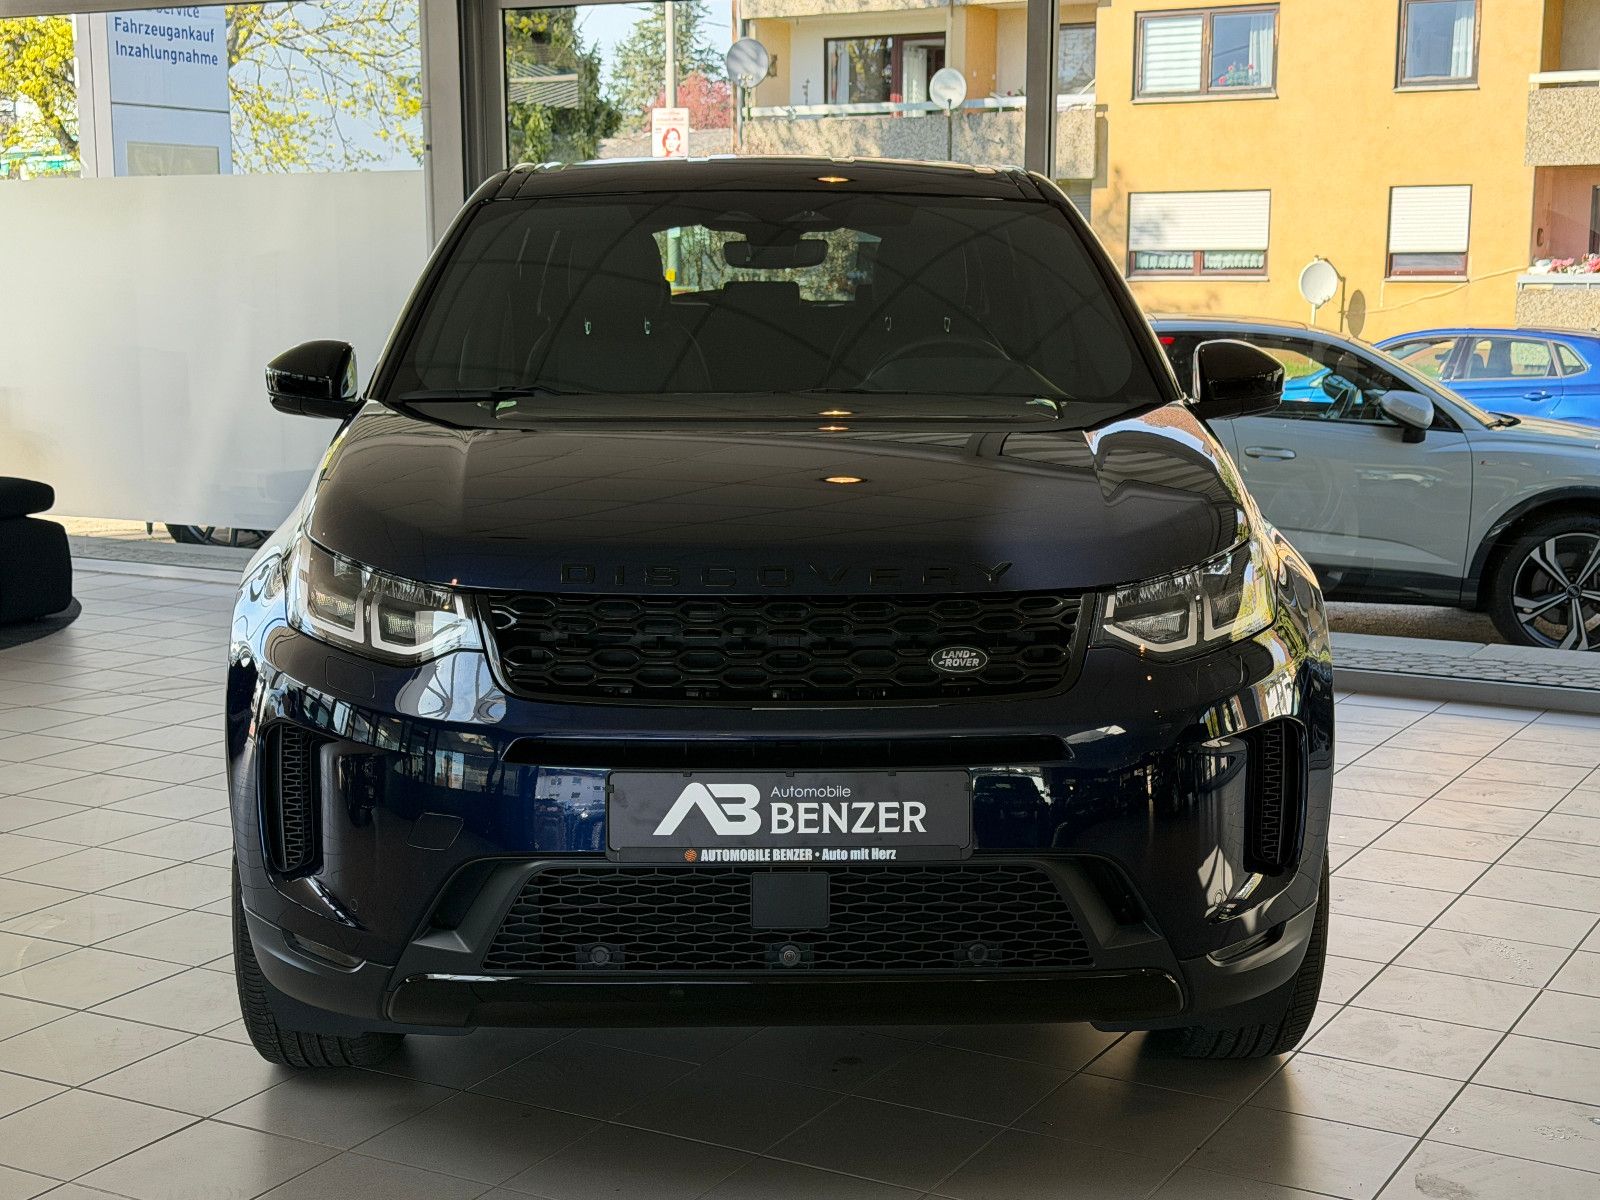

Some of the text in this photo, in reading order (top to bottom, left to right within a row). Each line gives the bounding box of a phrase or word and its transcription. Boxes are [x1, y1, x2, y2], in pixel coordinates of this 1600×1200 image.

[114, 16, 215, 42] Fahrzeugankauf
[115, 40, 218, 65] Inzahlungnahme
[560, 561, 1014, 588] DISCOVERY
[941, 650, 971, 659] LAND
[944, 658, 980, 667] ROVER
[770, 785, 851, 798] Automobile
[770, 802, 928, 834] BENZER
[700, 848, 897, 862] AUTOMOBILE BENZER Auto mit Herz
